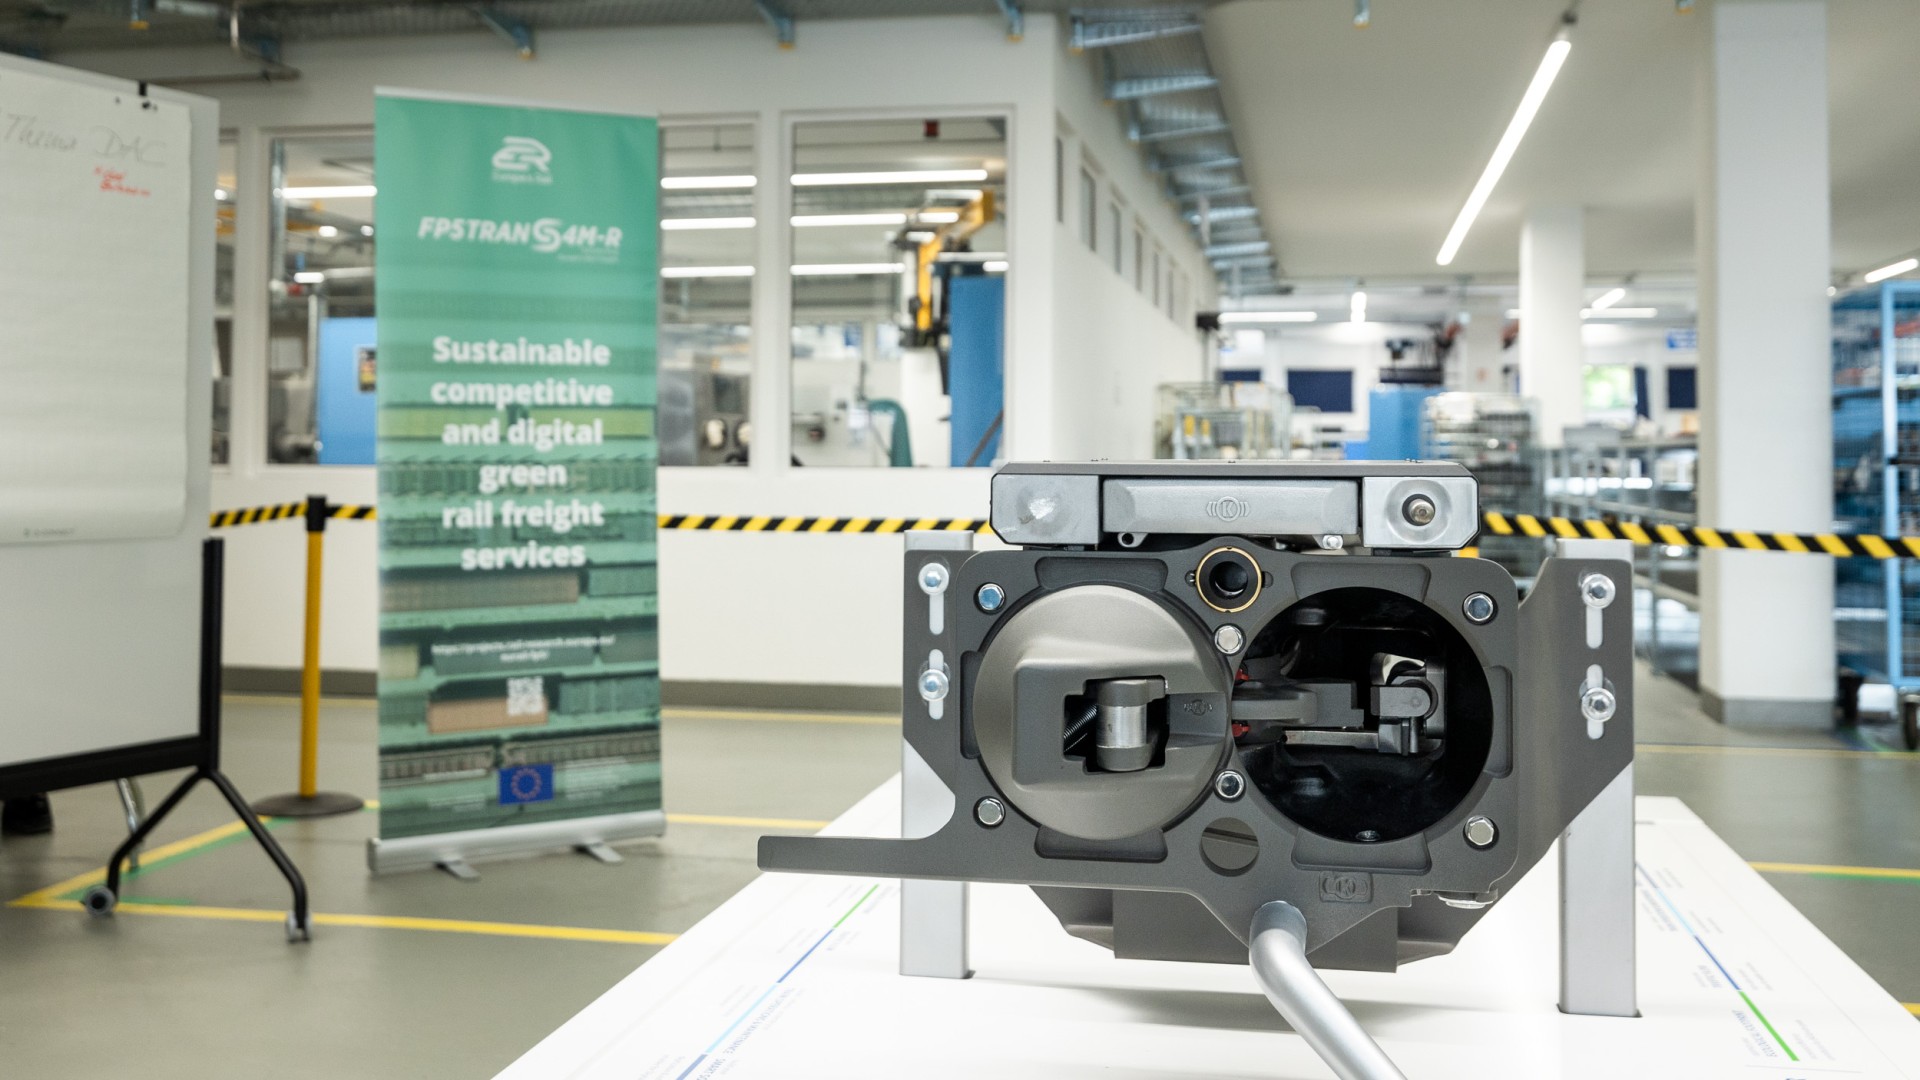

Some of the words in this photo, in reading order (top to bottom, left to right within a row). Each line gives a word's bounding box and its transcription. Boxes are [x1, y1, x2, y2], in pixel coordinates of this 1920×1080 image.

[433, 336, 611, 366] Sustainable
[430, 378, 614, 411] competitive
[442, 418, 500, 444] and
[507, 418, 603, 452] digital
[478, 464, 568, 493] green
[442, 500, 494, 528] rail
[501, 500, 605, 534] freight
[460, 540, 587, 570] services
